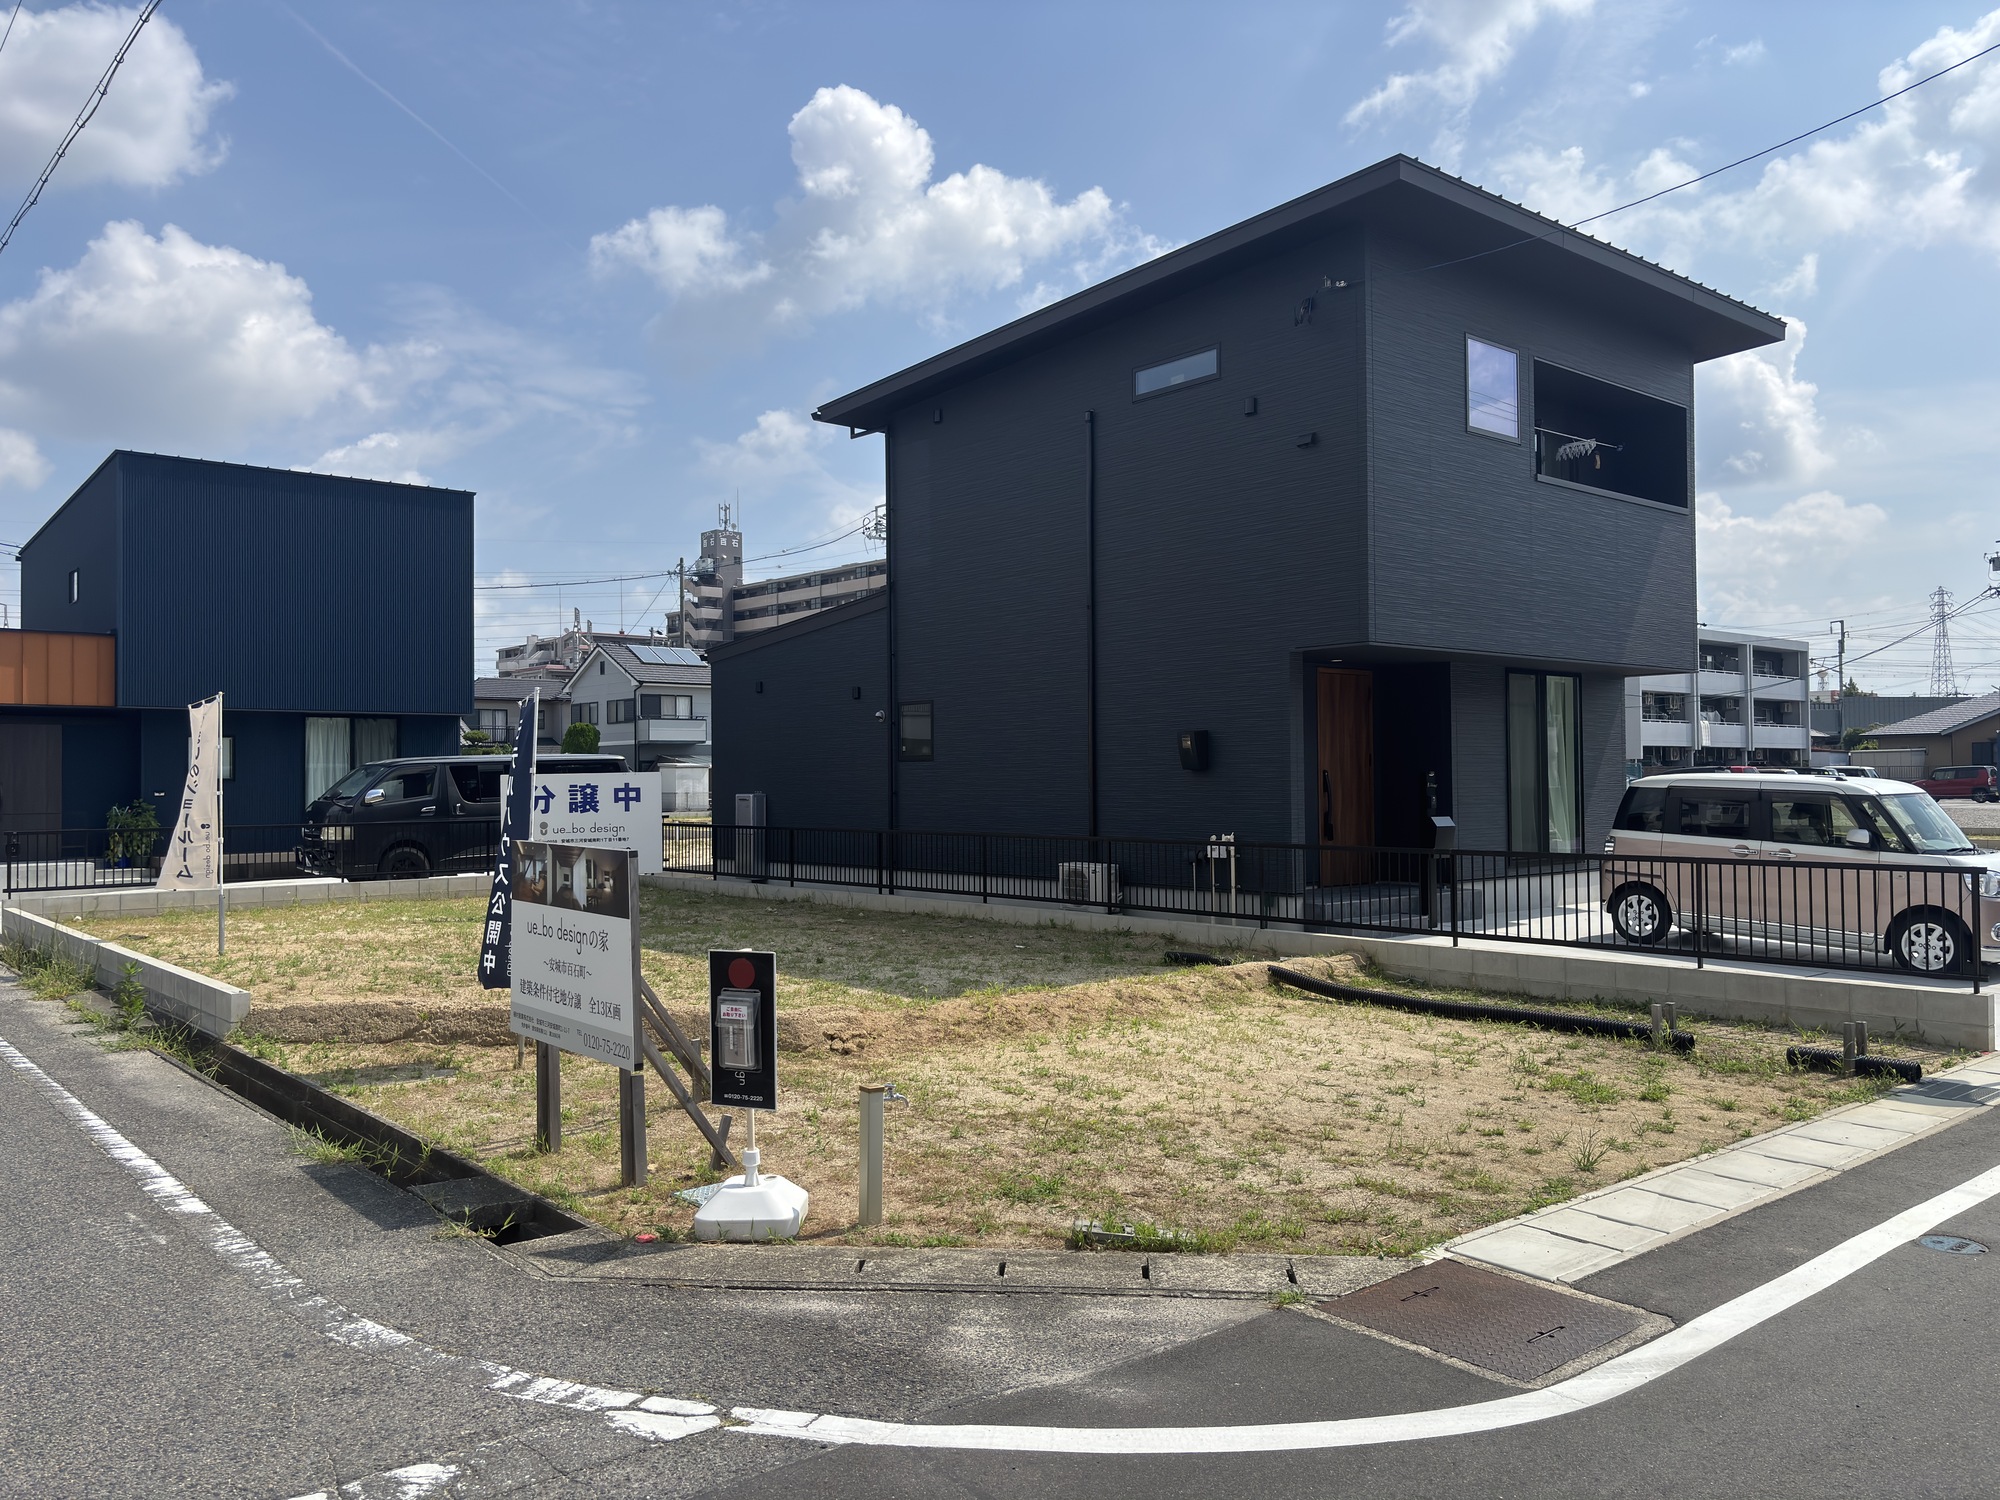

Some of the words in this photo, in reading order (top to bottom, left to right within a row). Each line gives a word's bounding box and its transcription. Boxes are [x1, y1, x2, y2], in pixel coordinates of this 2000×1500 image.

[720, 537, 739, 548] 百石
[533, 782, 642, 815] 分譲中
[552, 822, 586, 835] ue_bo
[589, 821, 626, 837] design
[527, 913, 554, 938] ue_bo
[556, 917, 609, 955] designの家
[588, 996, 622, 1022] 全13区画
[583, 1032, 631, 1061] 0120-75-2220
